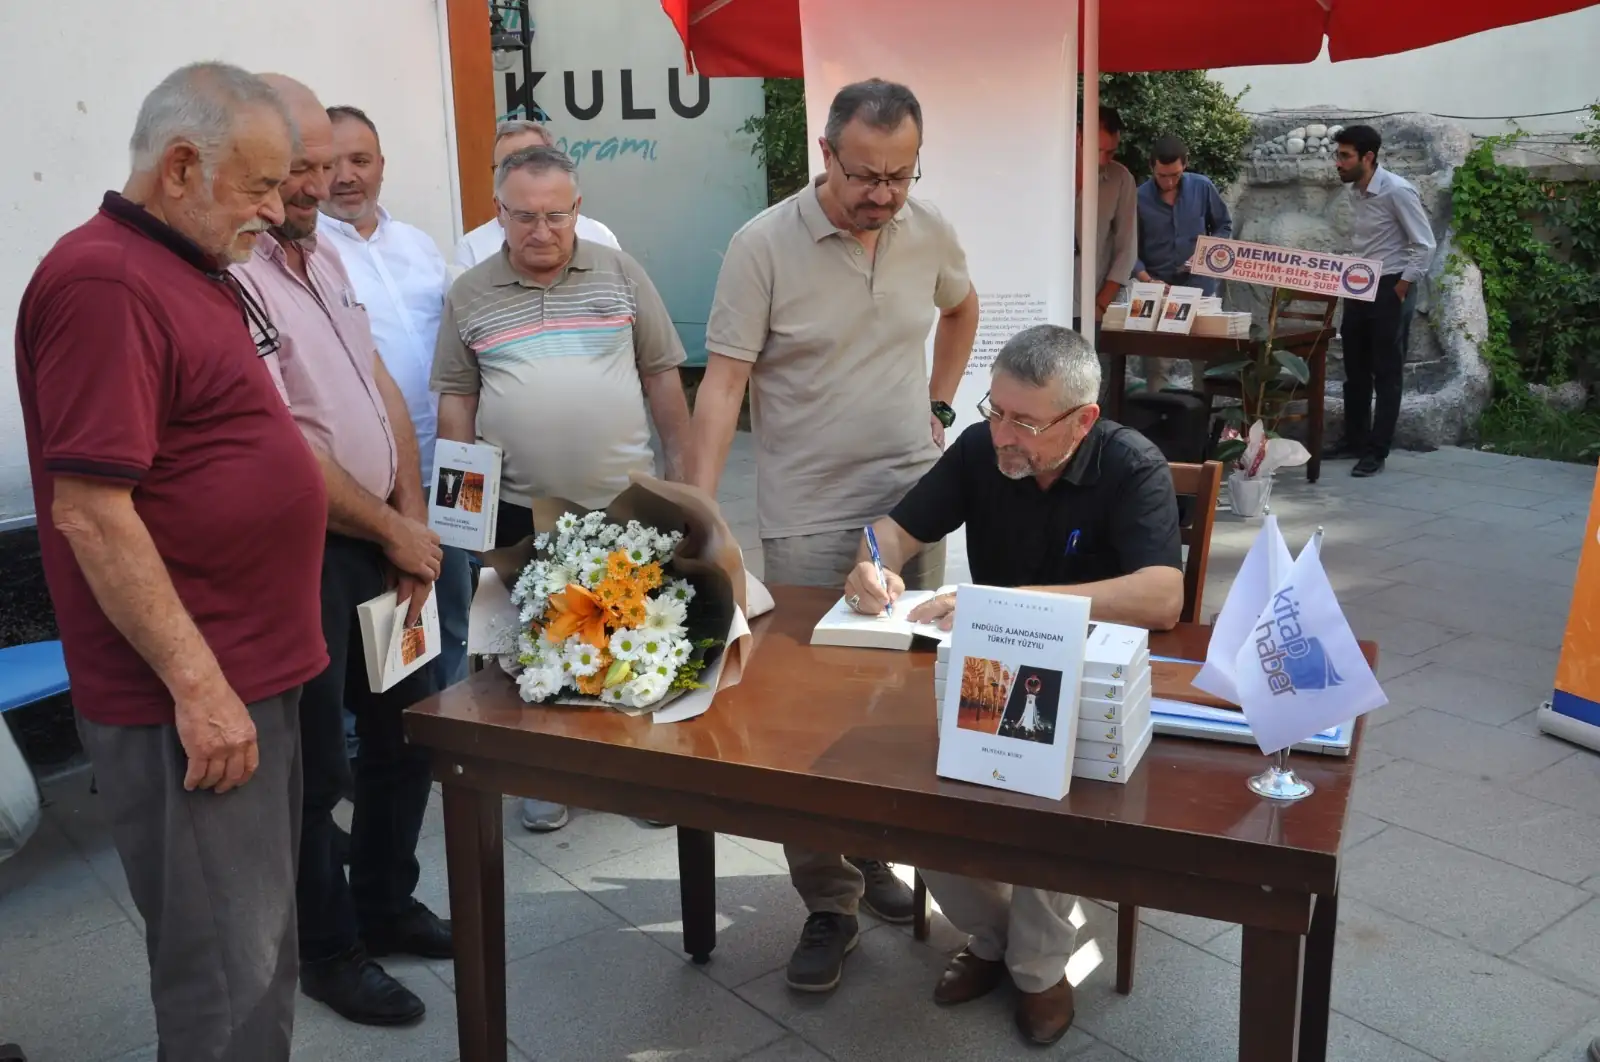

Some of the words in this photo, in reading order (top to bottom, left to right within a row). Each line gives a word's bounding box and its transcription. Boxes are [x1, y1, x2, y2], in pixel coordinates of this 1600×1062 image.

[1234, 258, 1340, 282] EĞİTİM-BİR-SEN
[1237, 247, 1343, 272] MEMUR-SEN
[1285, 277, 1311, 286] NOLU
[1313, 280, 1339, 291] ŞUBE
[971, 622, 1003, 633] ENDÜLÜS
[1005, 627, 1064, 642] AJANDASINDAN
[1273, 585, 1310, 660] kitap
[987, 634, 1016, 646] TÜRKİYE
[1018, 639, 1045, 650] YÜZYILI
[1255, 619, 1296, 697] haber
